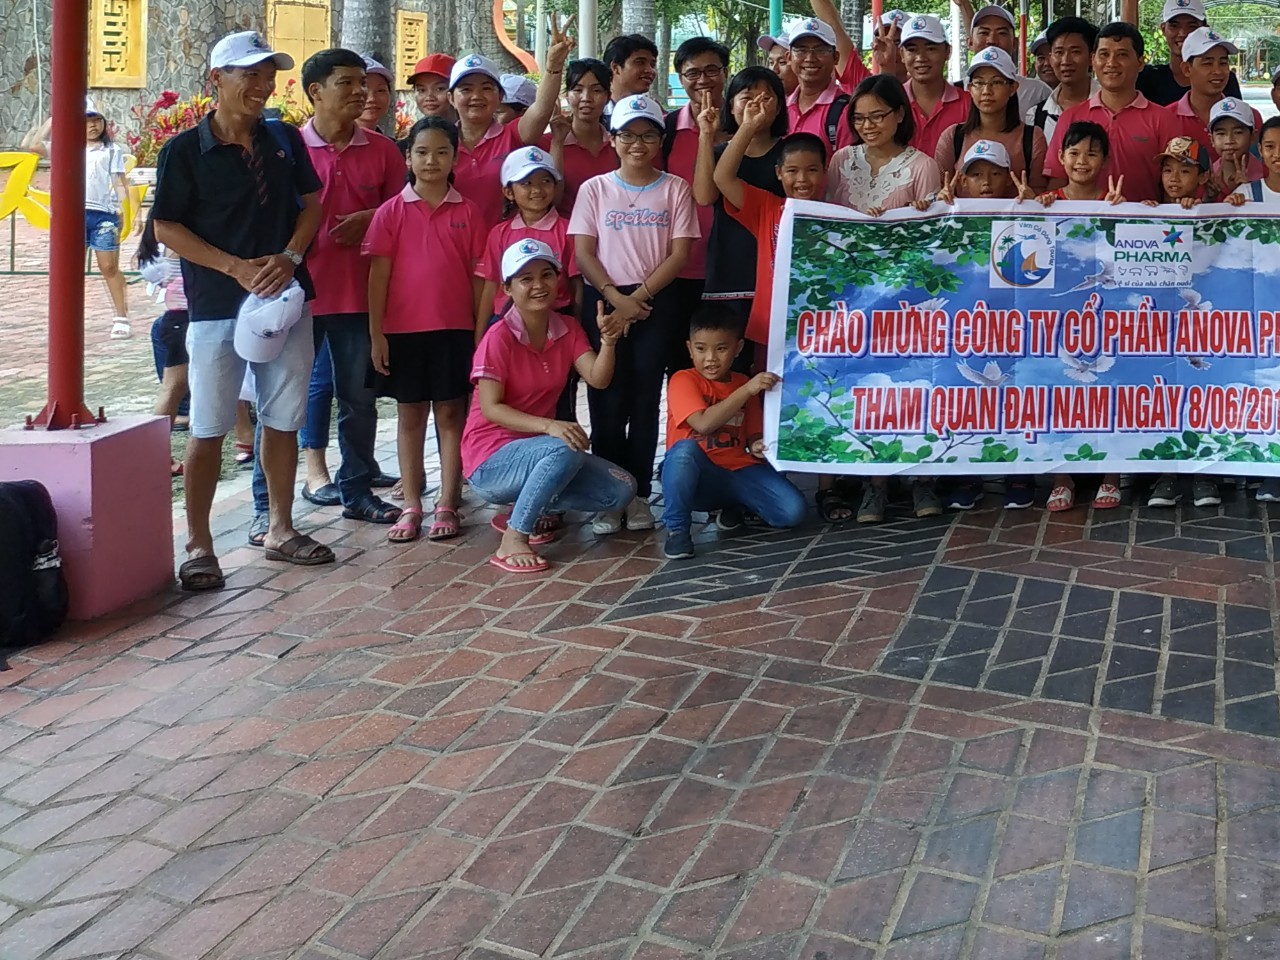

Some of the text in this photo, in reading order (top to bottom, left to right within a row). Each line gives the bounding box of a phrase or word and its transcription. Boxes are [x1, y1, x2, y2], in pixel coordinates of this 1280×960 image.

[605, 208, 670, 230] spoiled
[1114, 239, 1159, 249] ANOVA
[1114, 251, 1193, 263] PHARMA
[796, 300, 867, 356] CHÀO
[870, 300, 950, 356] MỪNG
[953, 300, 1025, 356] CÔNG
[1028, 310, 1060, 356] TY
[1063, 293, 1101, 356] CỔ
[1102, 296, 1171, 356] PHẦN
[1175, 310, 1256, 356] ANOVA
[852, 386, 925, 433] THAM
[929, 386, 1001, 438] QUAN
[1003, 386, 1050, 441] ĐẠI
[1052, 386, 1112, 433] NAM
[1116, 375, 1185, 433] NGÀY
